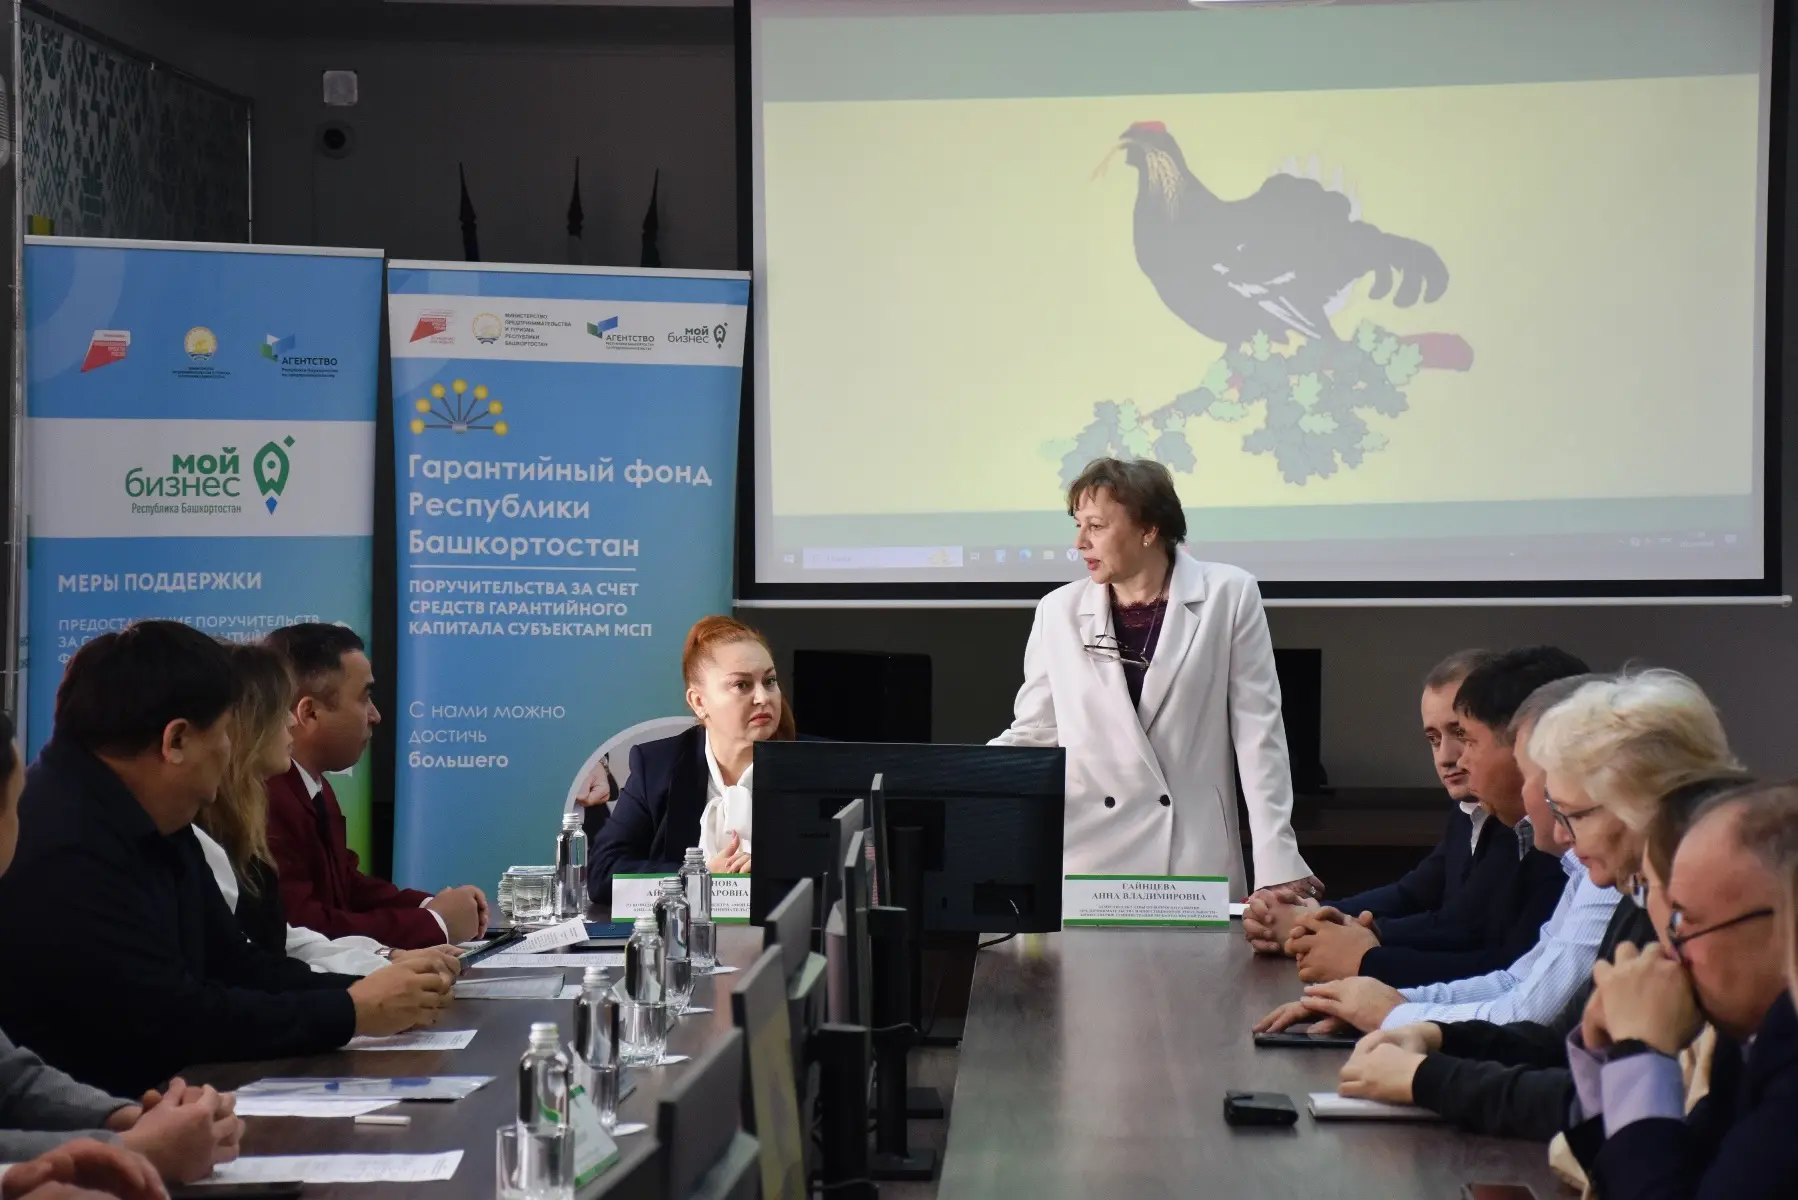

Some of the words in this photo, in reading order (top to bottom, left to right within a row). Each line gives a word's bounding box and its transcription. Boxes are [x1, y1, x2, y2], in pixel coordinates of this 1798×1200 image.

[606, 334, 655, 343] АГЕНТСТВО
[667, 332, 709, 344] бизнес
[685, 325, 709, 336] мой
[281, 357, 338, 366] АГЕНТСТВО
[172, 446, 240, 475] мой
[408, 453, 614, 485] Гарантийный
[623, 458, 713, 489] фонд
[125, 466, 241, 498] бизнес
[131, 502, 180, 515] Республика
[181, 502, 242, 515] Башкортостан
[408, 492, 590, 523] Республики
[408, 529, 640, 561] Башкортостан
[58, 573, 119, 593] МЕРЫ
[124, 571, 263, 593] ПОДДЕРЖКИ
[409, 579, 568, 596] ПОРУЧИТЕЛЬСТВА
[571, 582, 593, 596] ЗА
[596, 582, 639, 596] СЧЕТ
[409, 600, 485, 616] СРЕДСТВ
[489, 600, 628, 617] ГАРАНТИЙНОГО
[408, 621, 505, 636] КАПИТАЛА
[507, 622, 610, 637] СУБЪЕКТАМ
[614, 623, 653, 637] МСП
[58, 635, 78, 649] ЗА
[409, 701, 426, 719] С
[431, 704, 488, 719] нами
[493, 705, 566, 719] можно
[408, 729, 487, 744] достичь
[408, 750, 509, 768] большего
[1122, 881, 1177, 891] ГАЙНЦЕВА
[1091, 892, 1120, 900] АННА
[1123, 892, 1207, 901] ВЛАДИМИРОВНА
